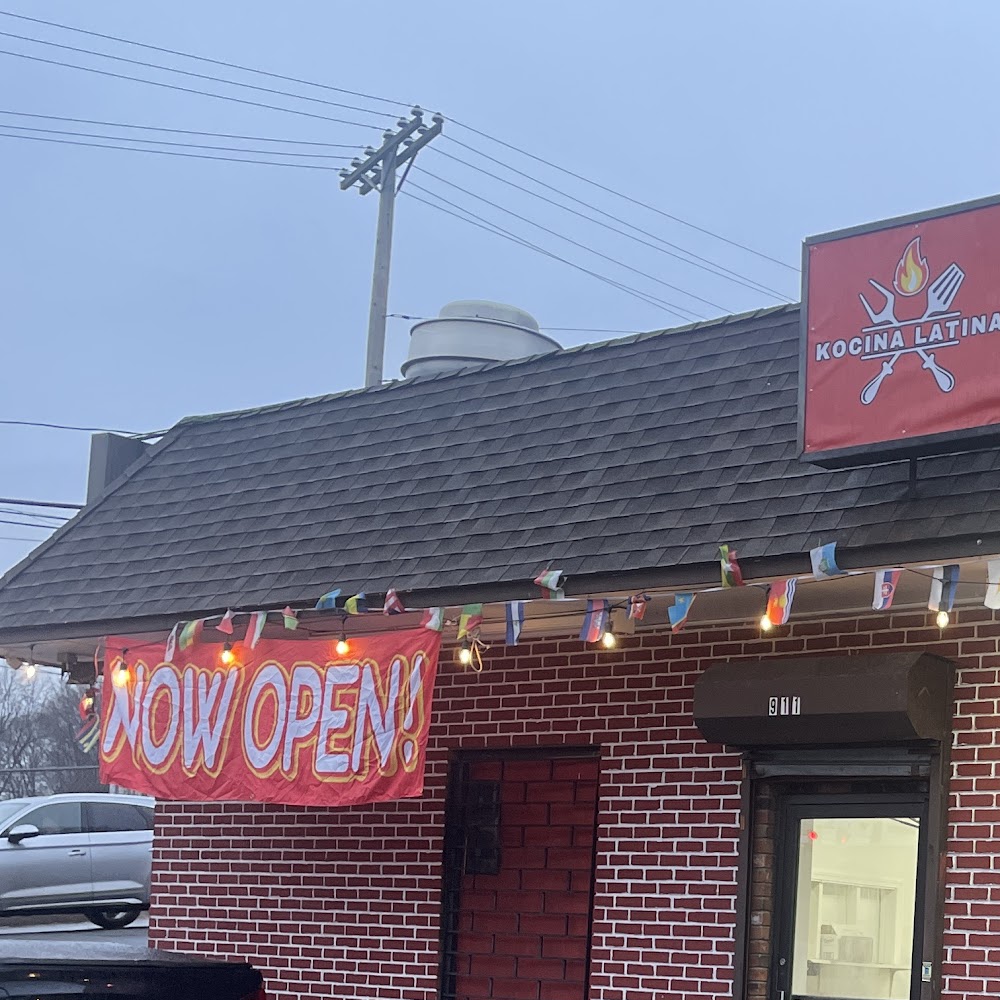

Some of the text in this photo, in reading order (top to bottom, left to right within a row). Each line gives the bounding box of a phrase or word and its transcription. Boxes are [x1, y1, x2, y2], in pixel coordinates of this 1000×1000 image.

[815, 329, 905, 361] KOCINA
[102, 650, 430, 783] NOW OPEN!
[769, 697, 800, 715] 911
